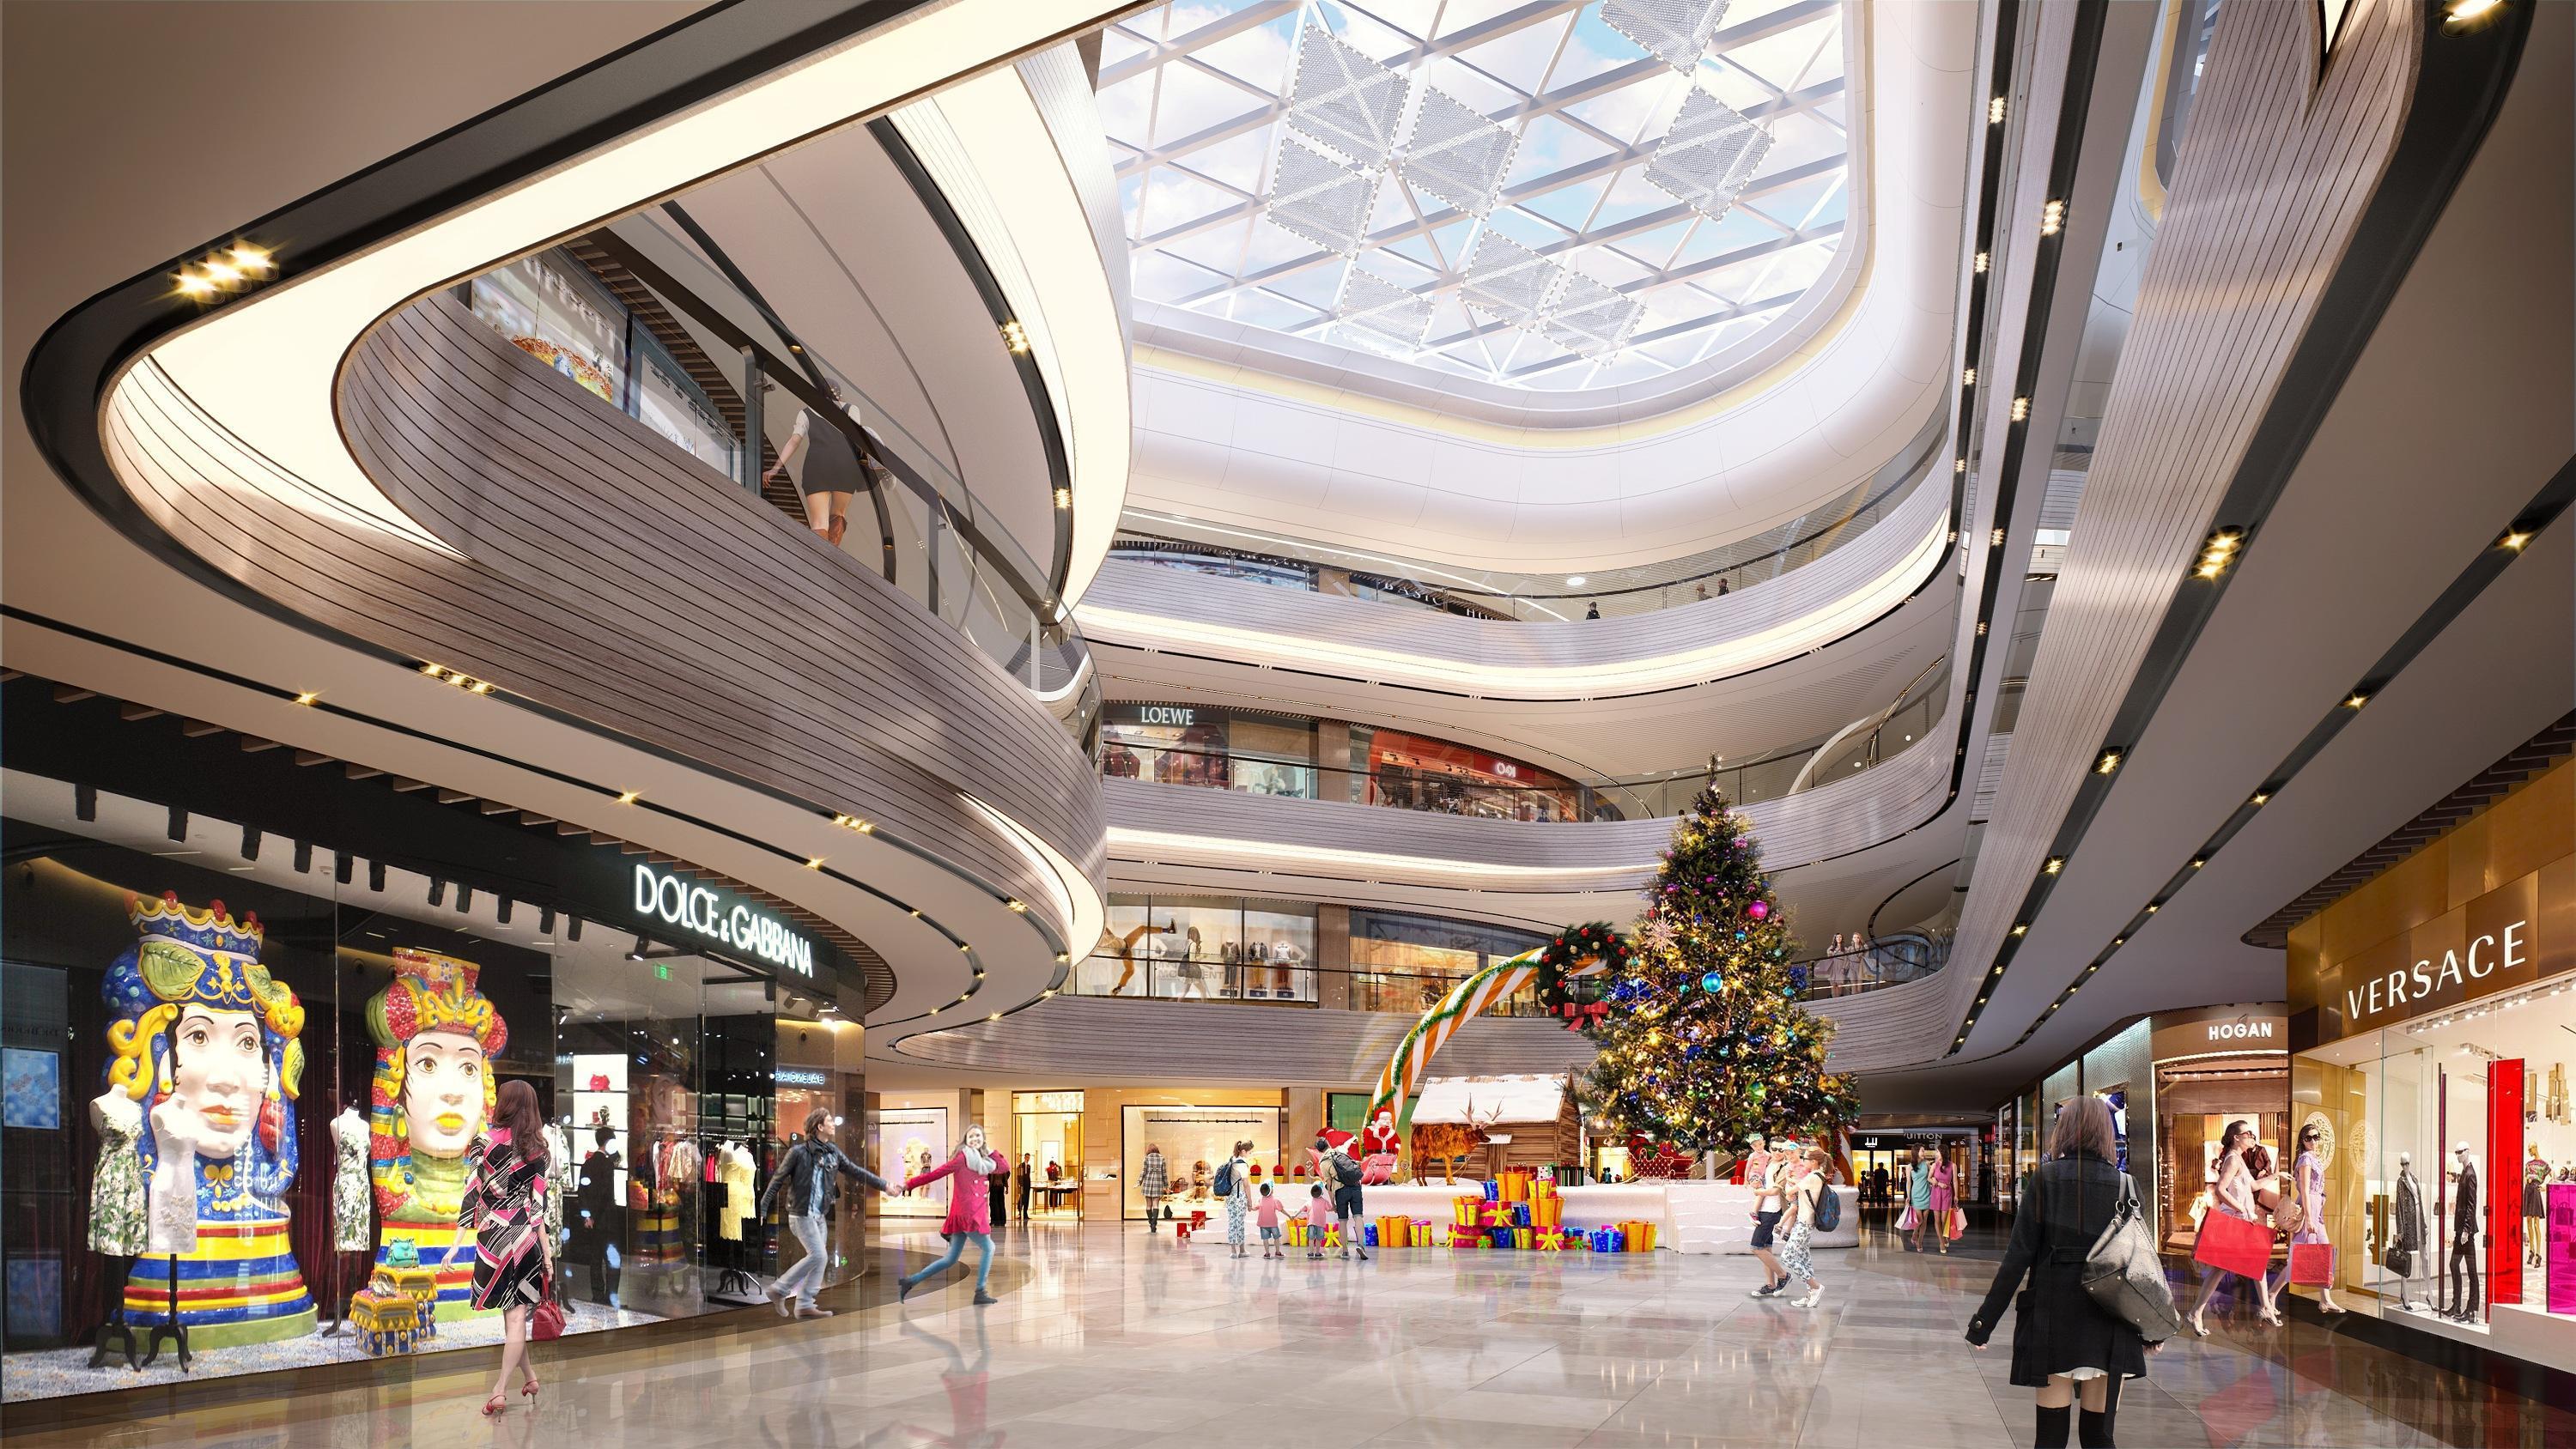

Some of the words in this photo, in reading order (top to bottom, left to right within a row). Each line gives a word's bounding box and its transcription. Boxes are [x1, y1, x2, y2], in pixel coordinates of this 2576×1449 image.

[1140, 706, 1194, 725] LOEWE
[2348, 919, 2527, 1021] VERSACE
[2208, 1022, 2273, 1041] HOGAN
